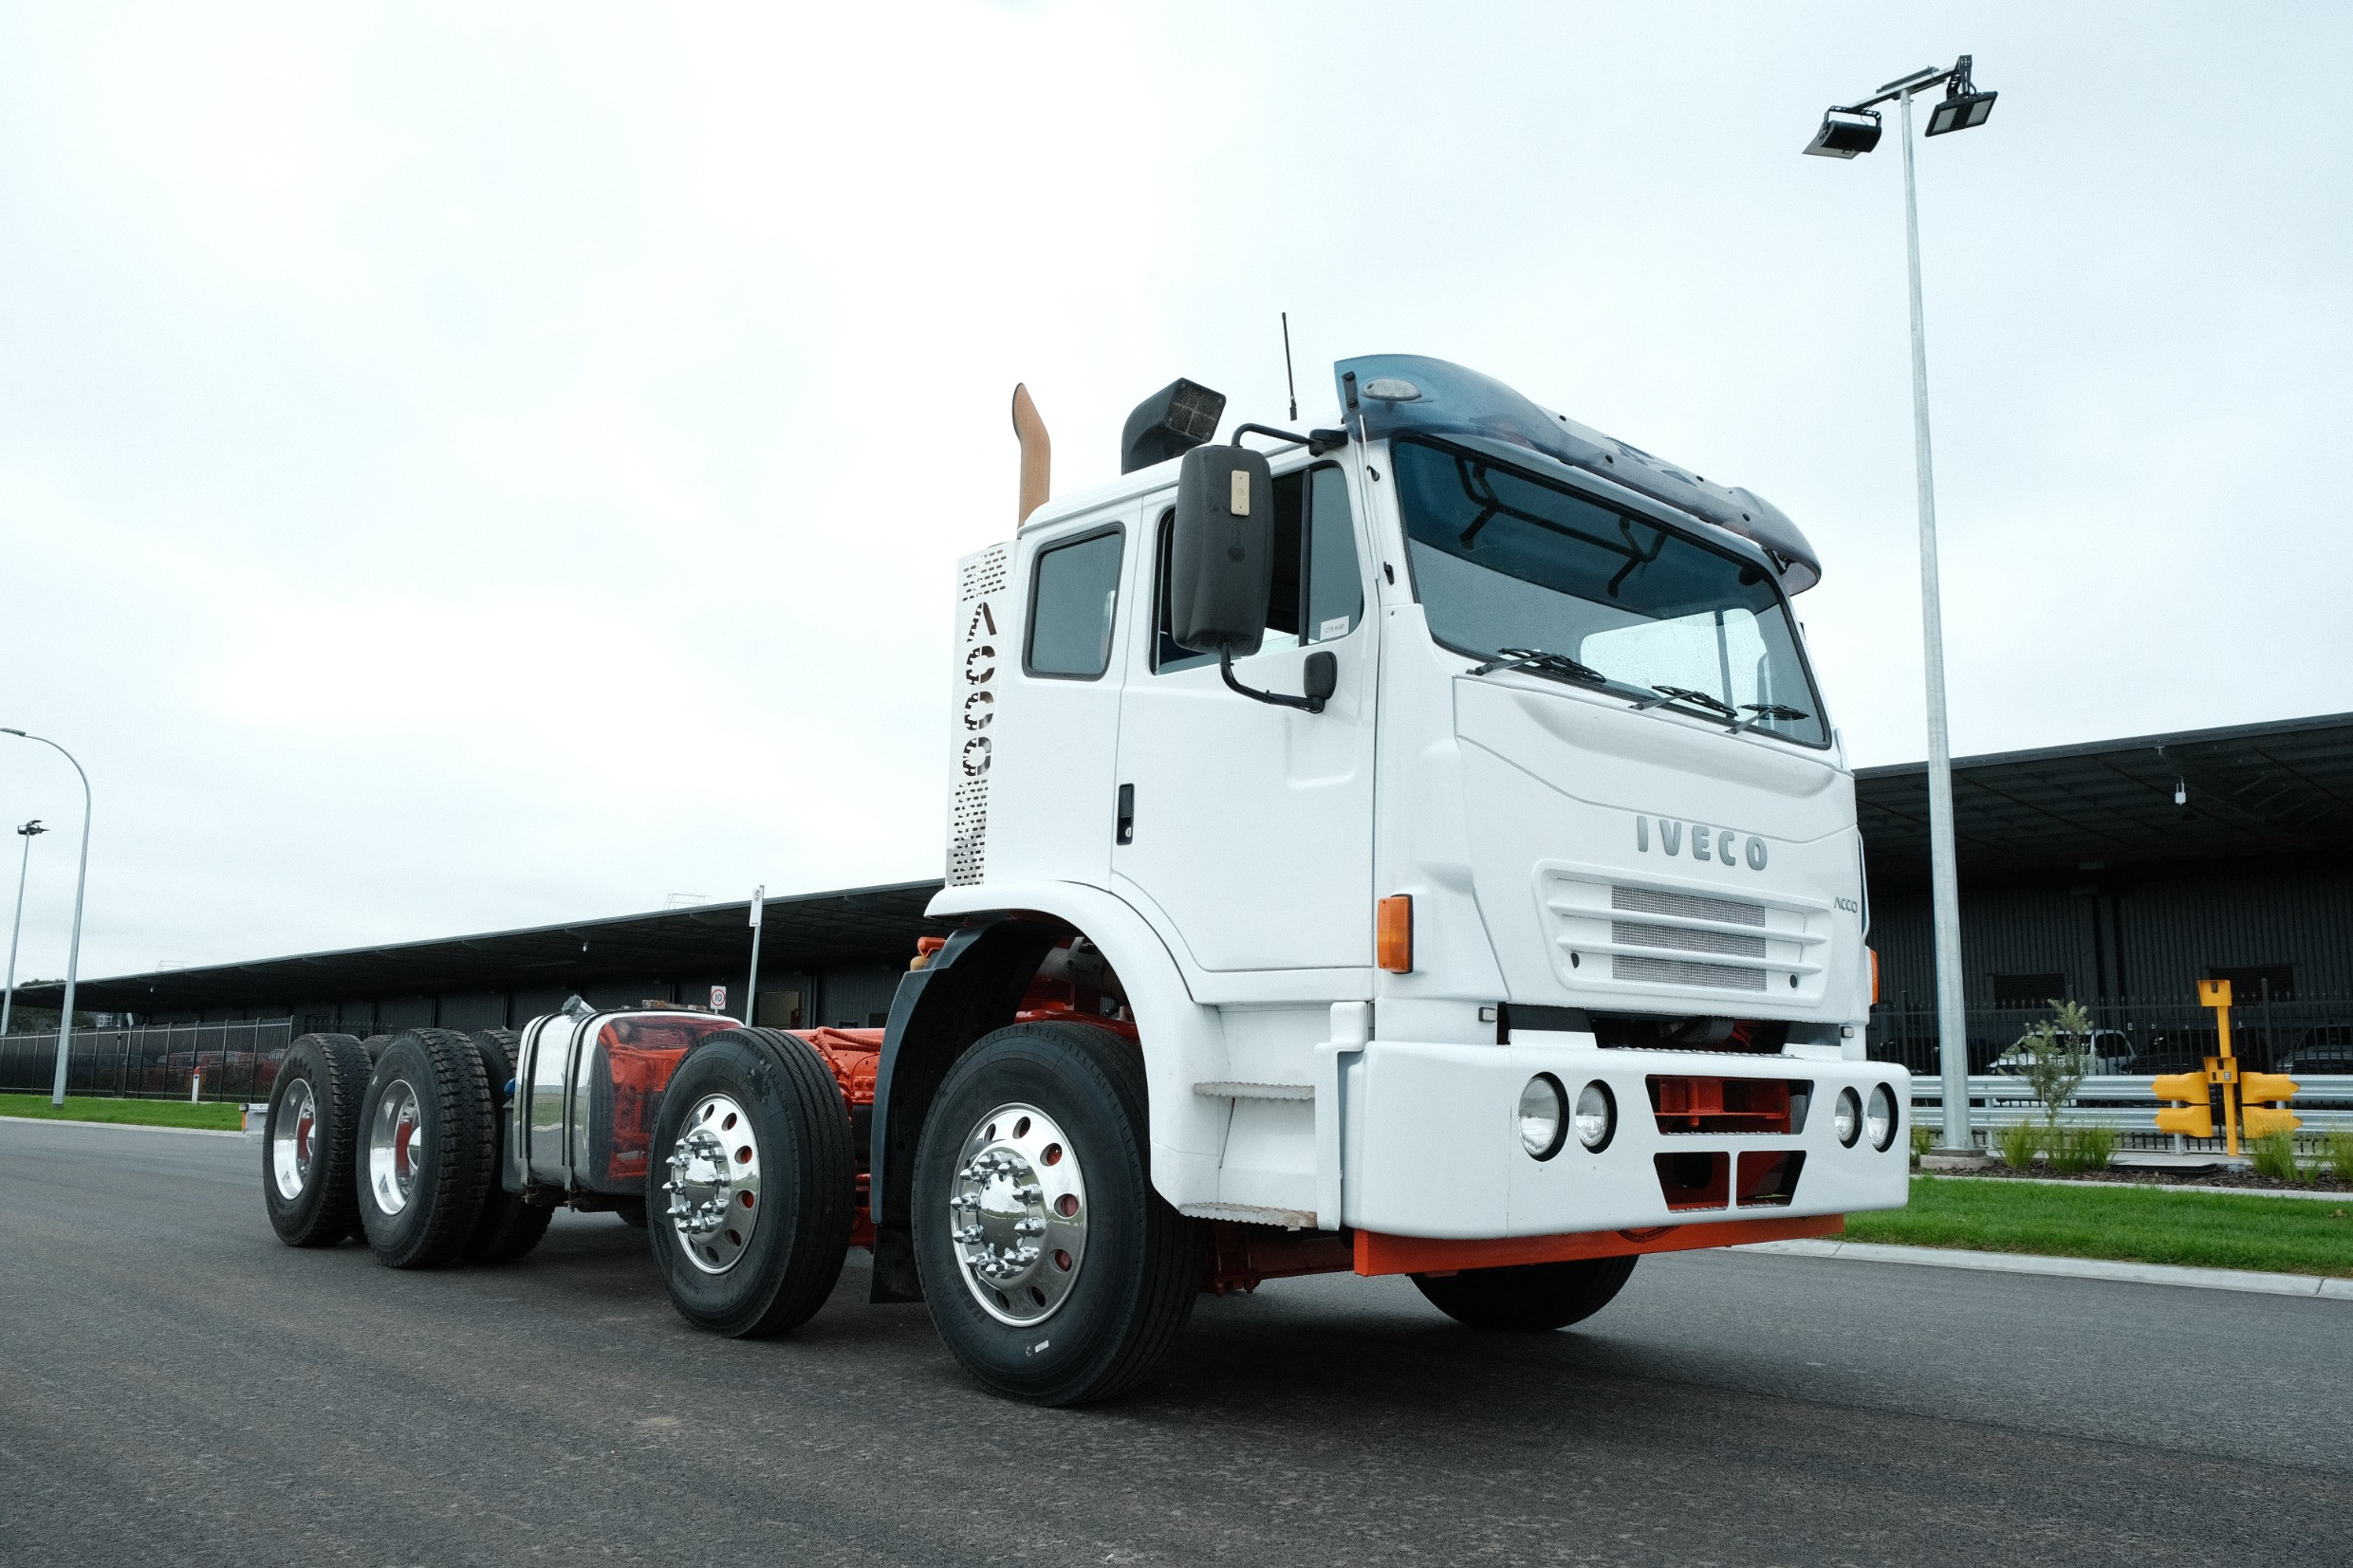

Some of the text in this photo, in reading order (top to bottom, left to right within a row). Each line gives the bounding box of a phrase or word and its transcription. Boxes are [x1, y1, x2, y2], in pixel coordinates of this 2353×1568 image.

[962, 601, 997, 777] ACCO
[1637, 815, 1768, 871] IVECO
[1834, 896, 1859, 913] ACCO
[714, 993, 723, 1002] 10
